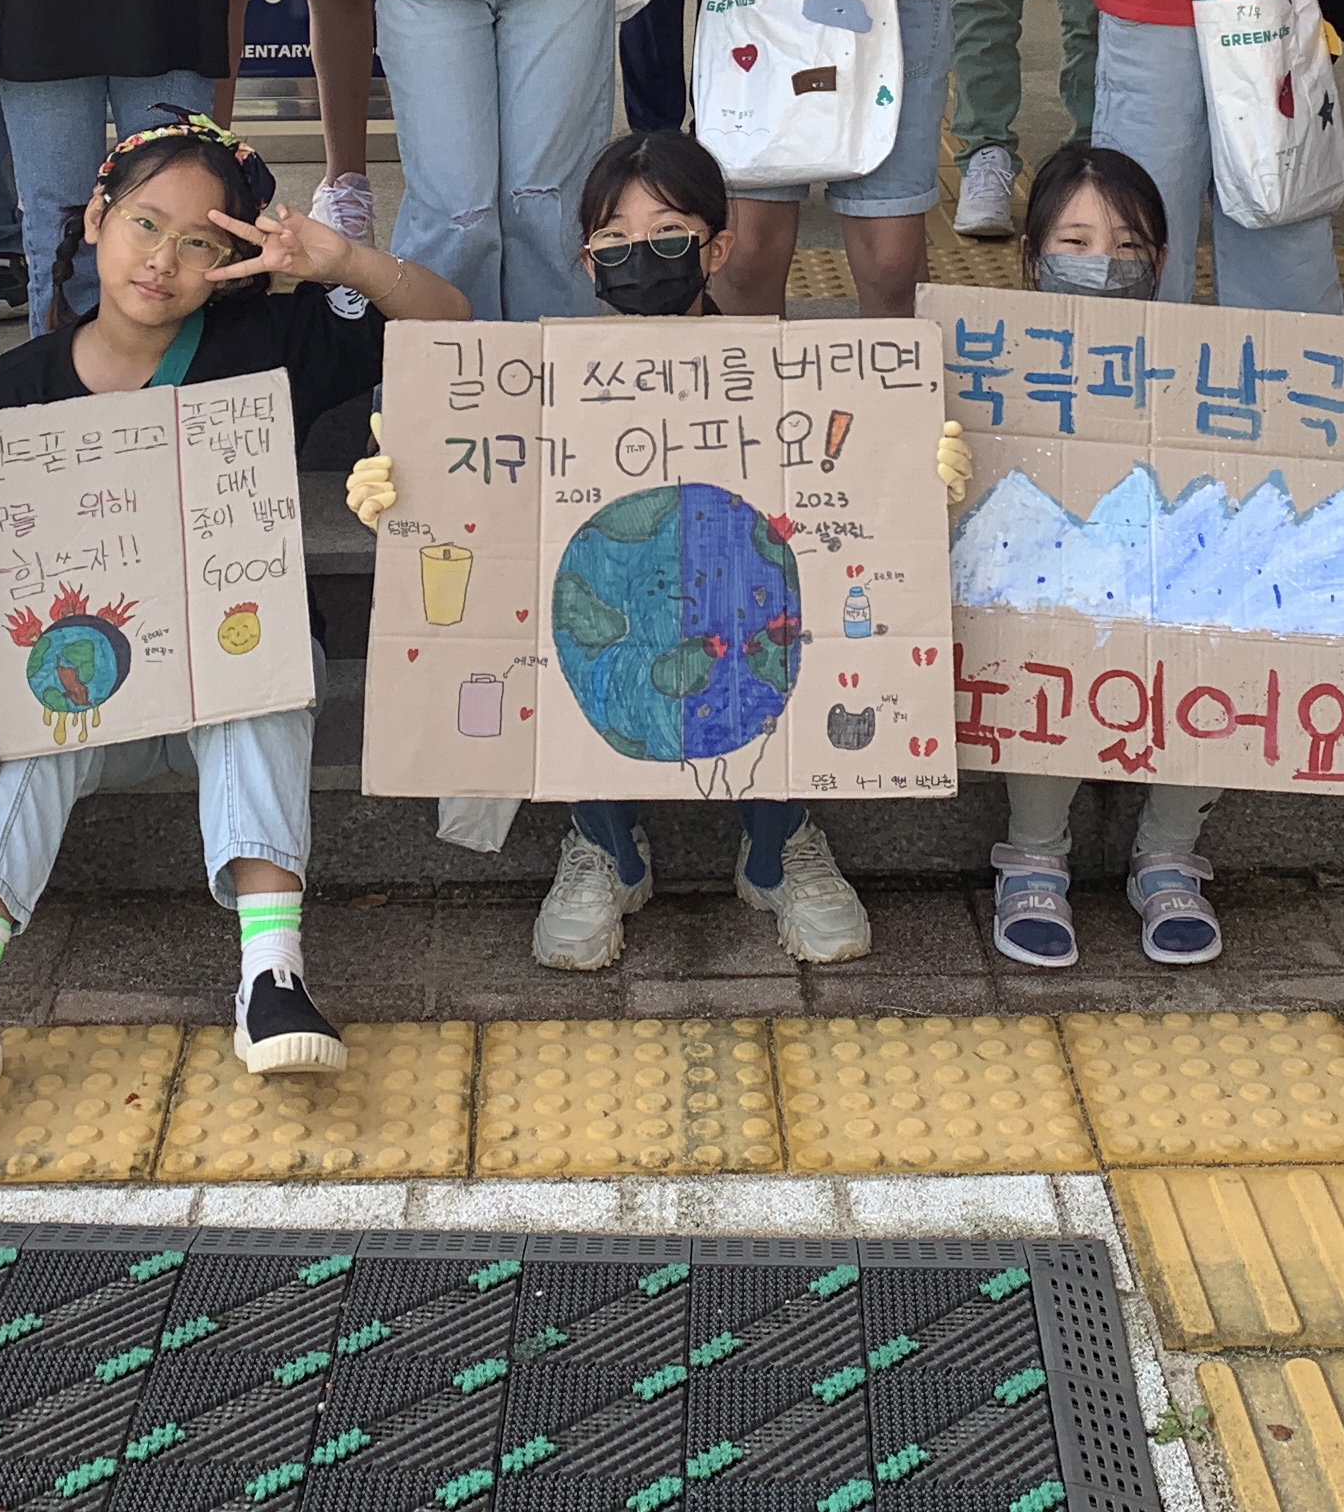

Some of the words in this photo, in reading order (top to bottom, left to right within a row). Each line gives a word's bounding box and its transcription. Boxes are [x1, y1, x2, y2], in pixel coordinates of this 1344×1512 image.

[241, 44, 311, 58] ENTARY
[433, 338, 555, 410] 길에
[580, 347, 755, 404] 쓰레기를
[772, 339, 939, 395] 버리면,
[944, 317, 1176, 434] 북극과
[181, 392, 275, 446] 플라스틱
[209, 427, 271, 465] 빨대
[445, 435, 576, 484] 지구가
[614, 410, 854, 482] 아파요!
[216, 464, 259, 498] 대신
[554, 489, 603, 505] 2013
[795, 490, 851, 508] 2023
[76, 488, 139, 520] 위해
[190, 503, 235, 539] 종이
[253, 496, 297, 533] 빨대
[387, 520, 420, 538] 텀블러
